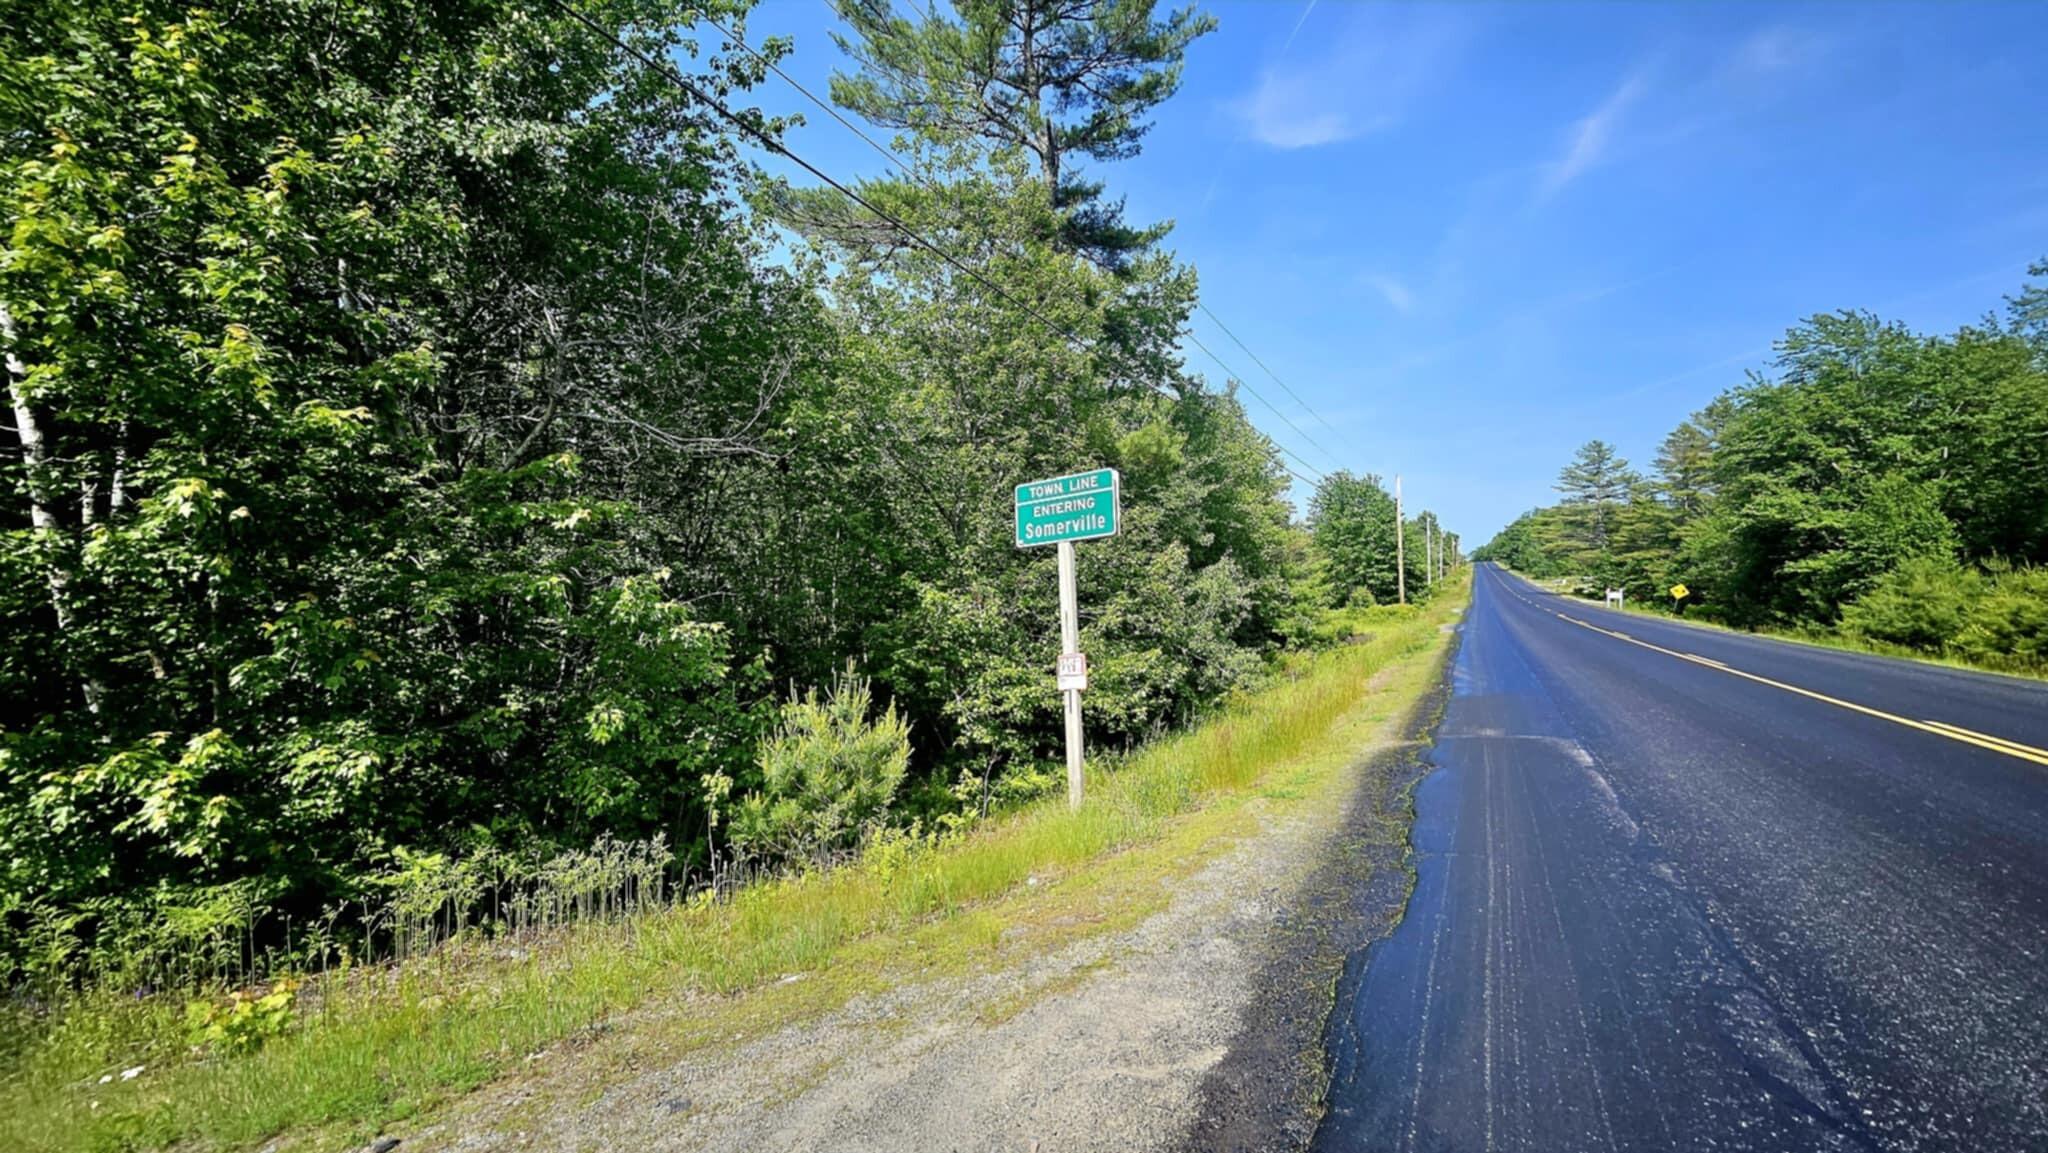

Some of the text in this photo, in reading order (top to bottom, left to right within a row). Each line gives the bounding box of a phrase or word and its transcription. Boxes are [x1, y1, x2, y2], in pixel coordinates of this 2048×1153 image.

[1029, 475, 1098, 498] TOWN LINE
[1033, 497, 1095, 517] ENTERING
[1025, 513, 1106, 539] Somerville
